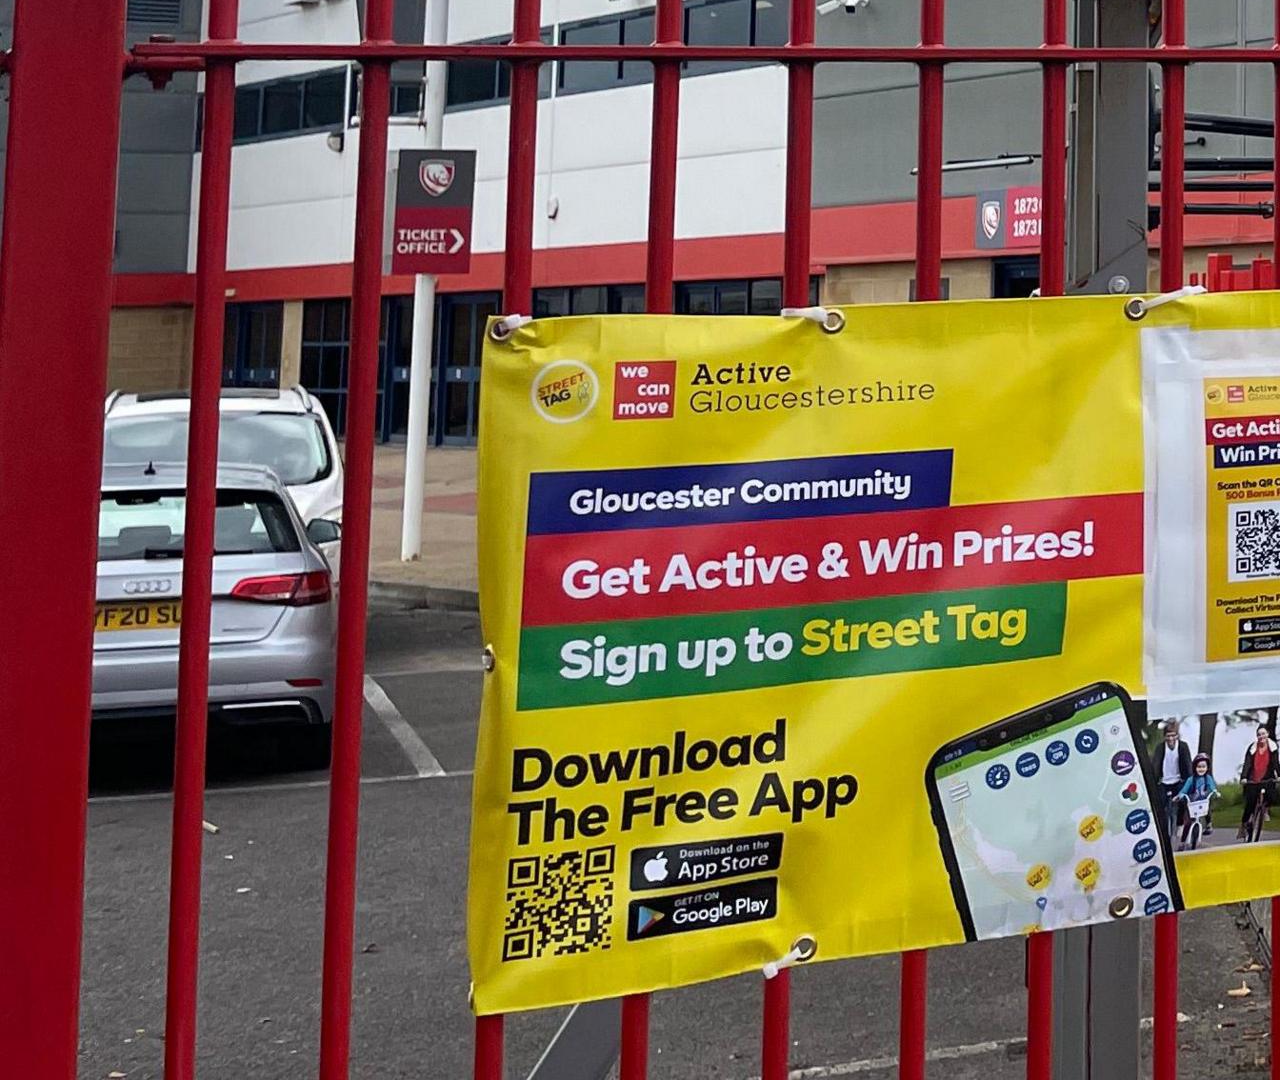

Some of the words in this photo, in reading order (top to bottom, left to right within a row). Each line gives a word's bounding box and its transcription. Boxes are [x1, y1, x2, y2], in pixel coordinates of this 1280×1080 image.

[1013, 197, 1039, 215] 1873
[398, 228, 447, 242] TICKET
[1013, 219, 1037, 237] 1873
[397, 242, 446, 255] OFFICE
[620, 365, 649, 378] we
[691, 362, 792, 387] Active
[537, 371, 586, 397] STREET
[637, 383, 670, 396] can
[1247, 384, 1278, 394] Active
[541, 389, 571, 408] TAG
[689, 380, 936, 415] Gloucestershire
[618, 401, 669, 415] move
[1211, 422, 1244, 439] Get
[1220, 444, 1256, 463] Win
[569, 484, 735, 517] Gloucester
[740, 468, 913, 505] Community
[1217, 480, 1240, 491] Scan
[1241, 479, 1258, 489] the
[1258, 478, 1274, 488] QR
[1225, 491, 1245, 501] 500
[1246, 488, 1275, 499] Bonus
[560, 558, 651, 600] Get
[658, 544, 808, 595] Active
[816, 541, 849, 580] &
[858, 532, 943, 574] Win
[952, 520, 1096, 568] Prizes!
[1215, 595, 1259, 607] Download
[1259, 594, 1275, 602] The
[1225, 605, 1254, 615] Collect
[558, 637, 667, 688] Sign
[677, 637, 735, 678] up
[744, 627, 793, 663] to
[799, 609, 940, 657] Street
[946, 603, 1028, 648] Tag
[511, 717, 787, 793] Download
[507, 797, 607, 846] The
[620, 786, 739, 832] Free
[749, 770, 859, 824] App
[1130, 820, 1147, 832] NFC
[678, 845, 733, 860] Download
[735, 844, 751, 854] on
[752, 840, 770, 852] the
[677, 859, 718, 881] App
[720, 851, 769, 874] Store
[674, 895, 694, 908] GET
[694, 893, 704, 905] IT
[704, 891, 720, 904] ON
[672, 903, 733, 928] Google
[735, 896, 770, 918] Play
